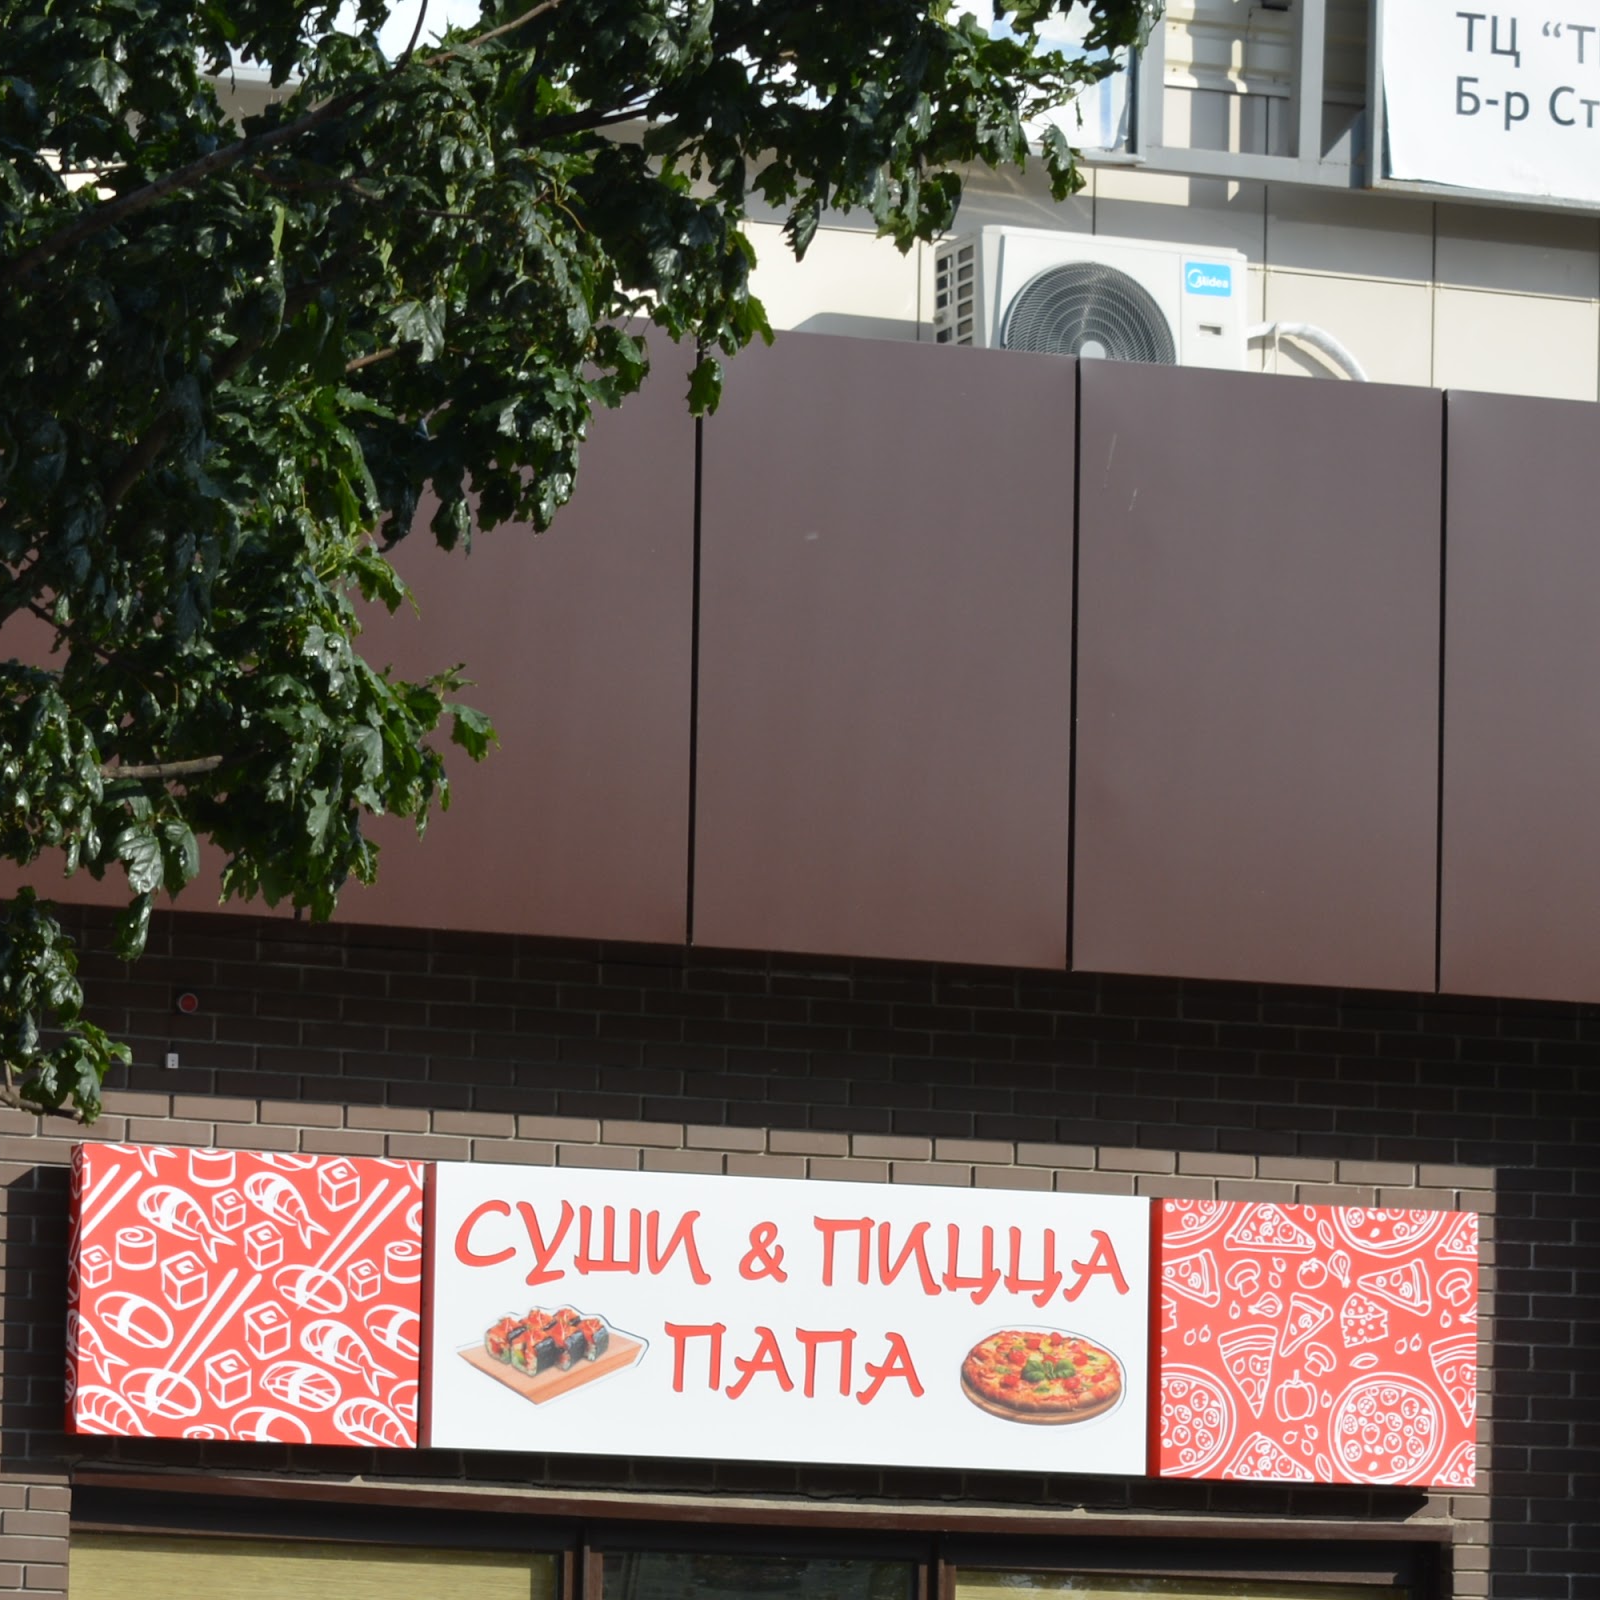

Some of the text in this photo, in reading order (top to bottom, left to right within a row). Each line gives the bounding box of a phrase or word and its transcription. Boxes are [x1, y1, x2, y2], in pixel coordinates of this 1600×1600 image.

[1455, 11, 1522, 68] ТЦ
[1455, 75, 1530, 131] Б-р
[1187, 268, 1229, 289] Midea
[454, 1199, 1131, 1309] СУШИ & ПИЦЦА
[664, 1320, 925, 1406] ПАПА
